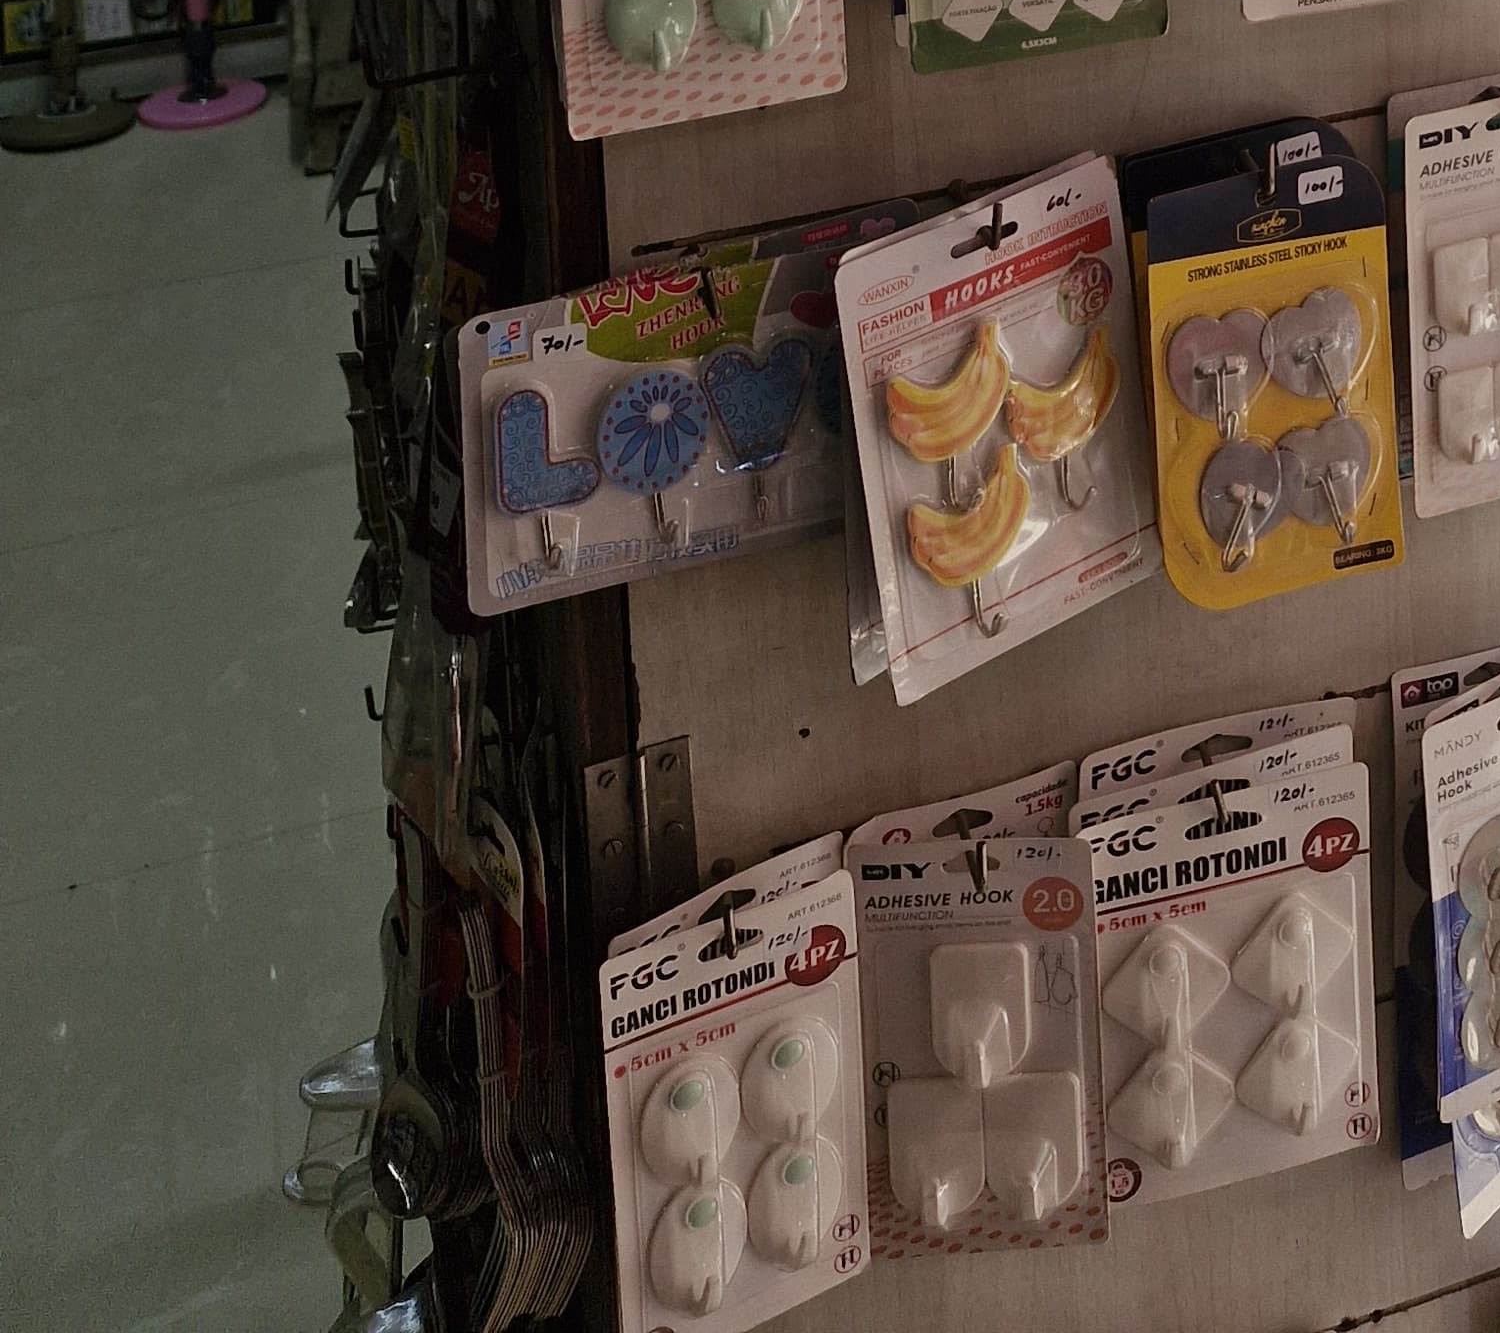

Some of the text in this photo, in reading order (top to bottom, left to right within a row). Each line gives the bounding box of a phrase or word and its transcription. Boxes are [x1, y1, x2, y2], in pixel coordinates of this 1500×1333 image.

[1419, 122, 1478, 149] DIY
[1420, 149, 1494, 178] ADHESIVE
[1304, 176, 1343, 194] 100/-
[1187, 236, 1348, 282] STRONG STAINLESS STEEL STICKY HOOK
[861, 264, 1016, 336] FASHION HOOKS
[862, 276, 910, 304] WANXIN
[541, 335, 585, 355] 70/-
[1091, 749, 1157, 790] FGC
[1437, 755, 1498, 788] Adhesive
[1024, 794, 1064, 816] 1.5kg
[1273, 782, 1315, 803] 120/-
[1437, 779, 1472, 803] Hook
[1306, 832, 1355, 858] 4PZ
[861, 862, 931, 880] DIY
[1175, 836, 1288, 894] ROTONDI
[865, 889, 1014, 910] ADHESIVE HOOK
[1032, 889, 1075, 913] 2.0
[1109, 901, 1206, 931] 5cm 5cm
[788, 937, 840, 972] 4PZ
[610, 954, 680, 1000] FGC
[611, 961, 776, 1038] GANCI ROTONDI
[630, 1021, 737, 1071] 5cm 5cm
